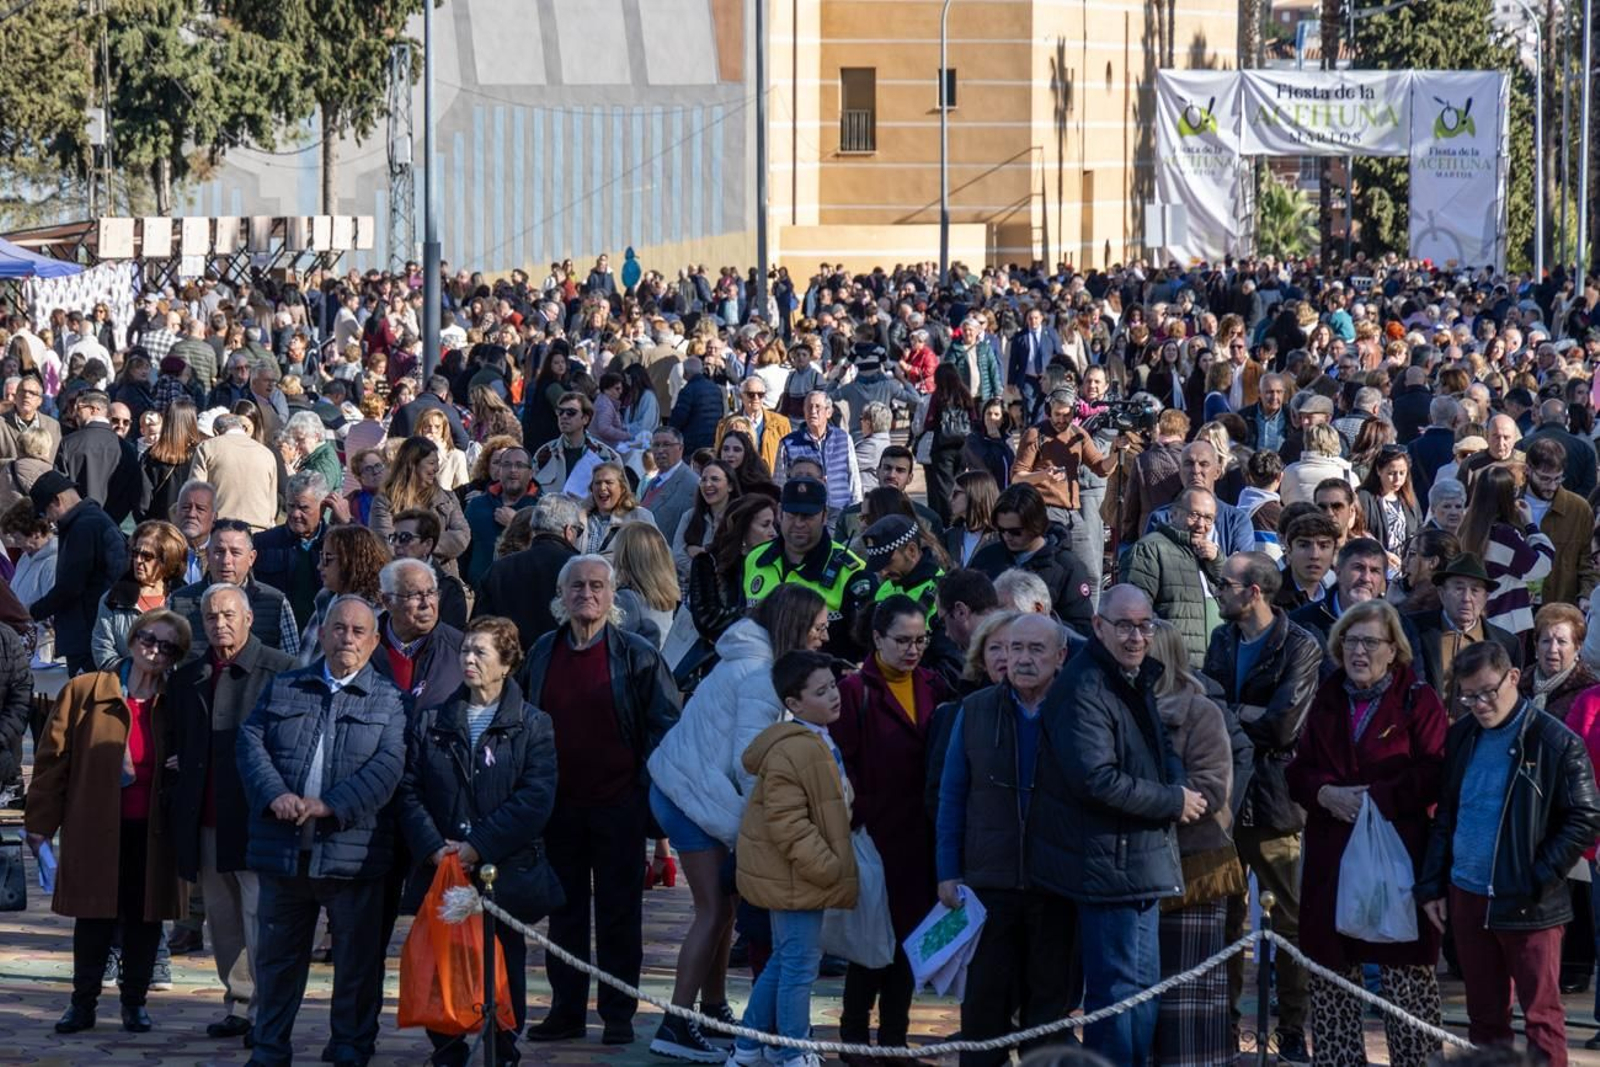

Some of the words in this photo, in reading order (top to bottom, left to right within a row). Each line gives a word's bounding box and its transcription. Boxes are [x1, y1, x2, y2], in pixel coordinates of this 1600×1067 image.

[1276, 84, 1330, 99] Fiesta
[1334, 84, 1355, 99] de
[1359, 84, 1375, 99] la
[1253, 104, 1400, 127] ACEITUNA
[1289, 131, 1362, 145] MARTOS
[1429, 147, 1457, 156] Fiesta
[1459, 147, 1470, 156] de
[1472, 147, 1480, 156] la
[1417, 157, 1492, 170] ACEITUNA
